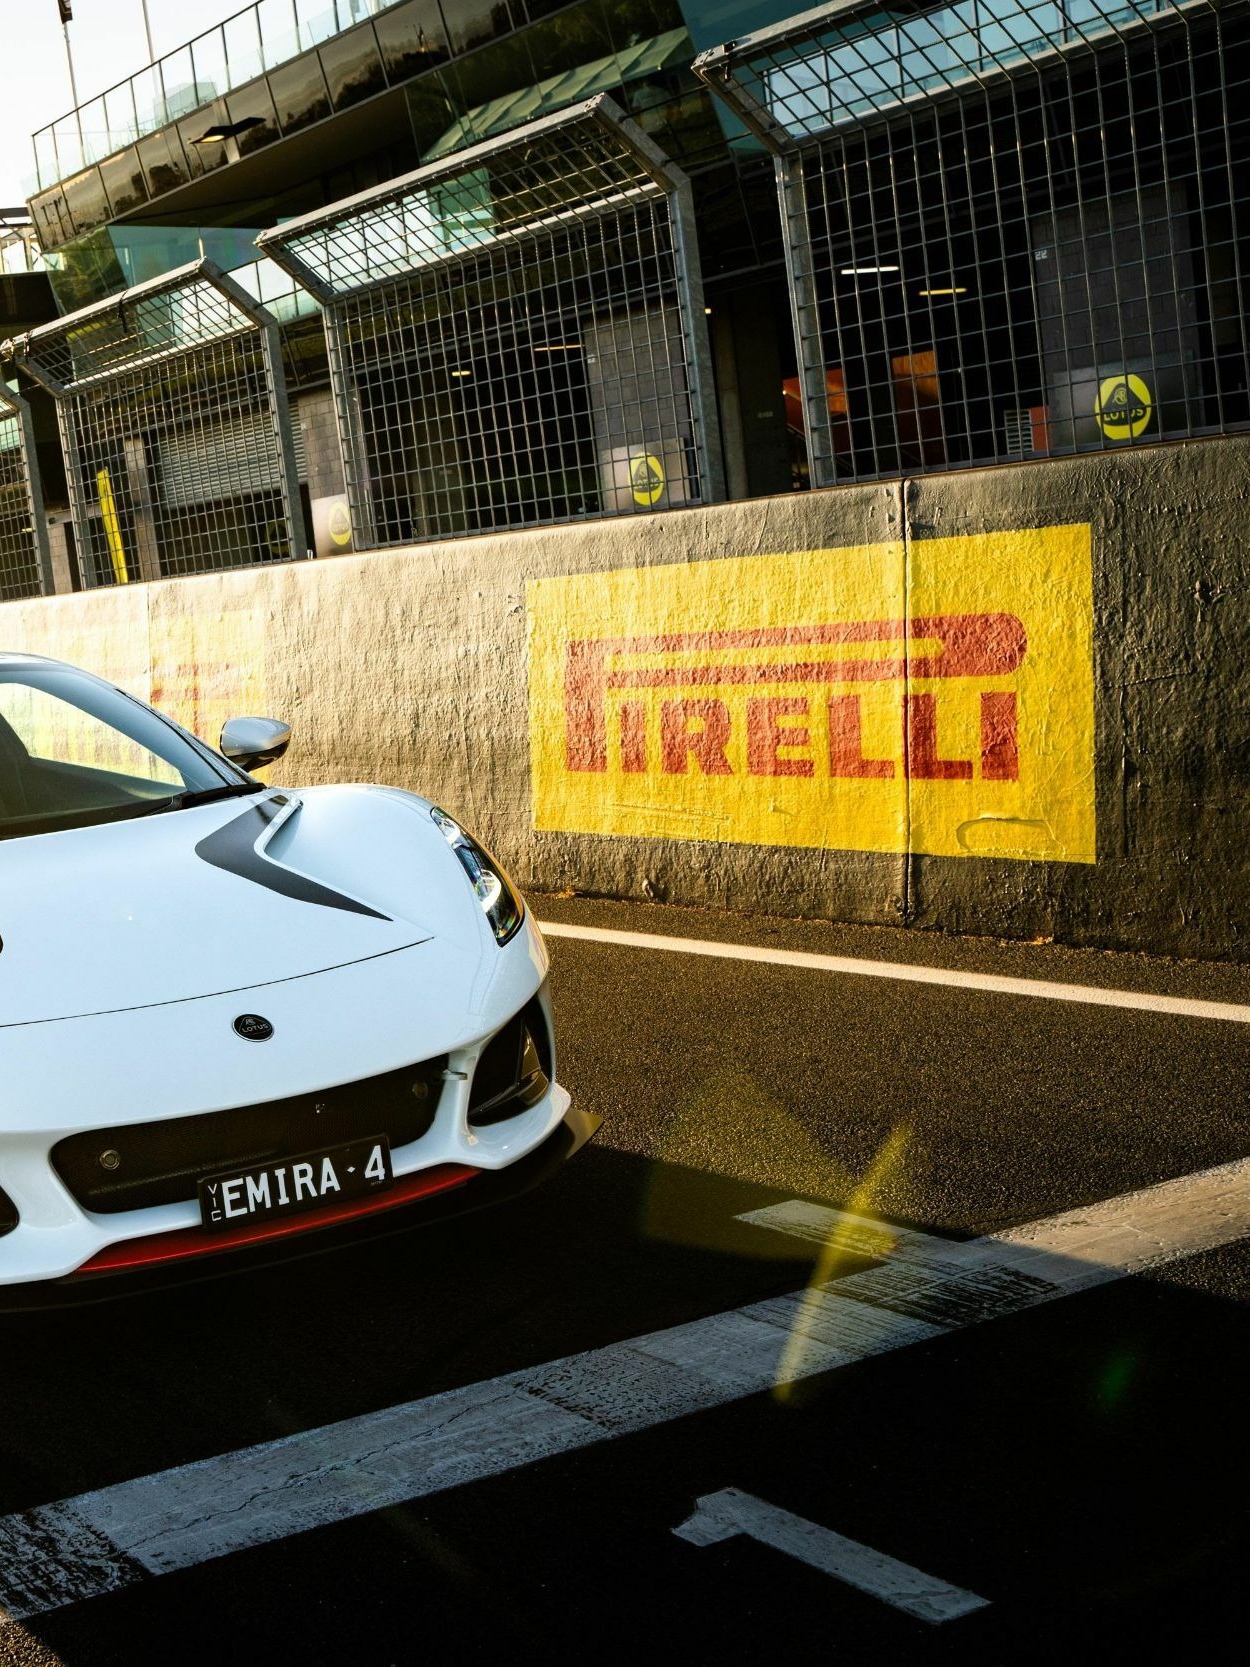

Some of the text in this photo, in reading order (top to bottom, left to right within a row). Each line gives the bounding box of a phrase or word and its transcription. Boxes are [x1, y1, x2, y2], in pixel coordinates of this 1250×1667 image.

[565, 612, 1028, 780] PIRELLI
[241, 1023, 269, 1033] LOTUS
[207, 1183, 222, 1222] VIC
[221, 1144, 386, 1219] EMIRA 4
